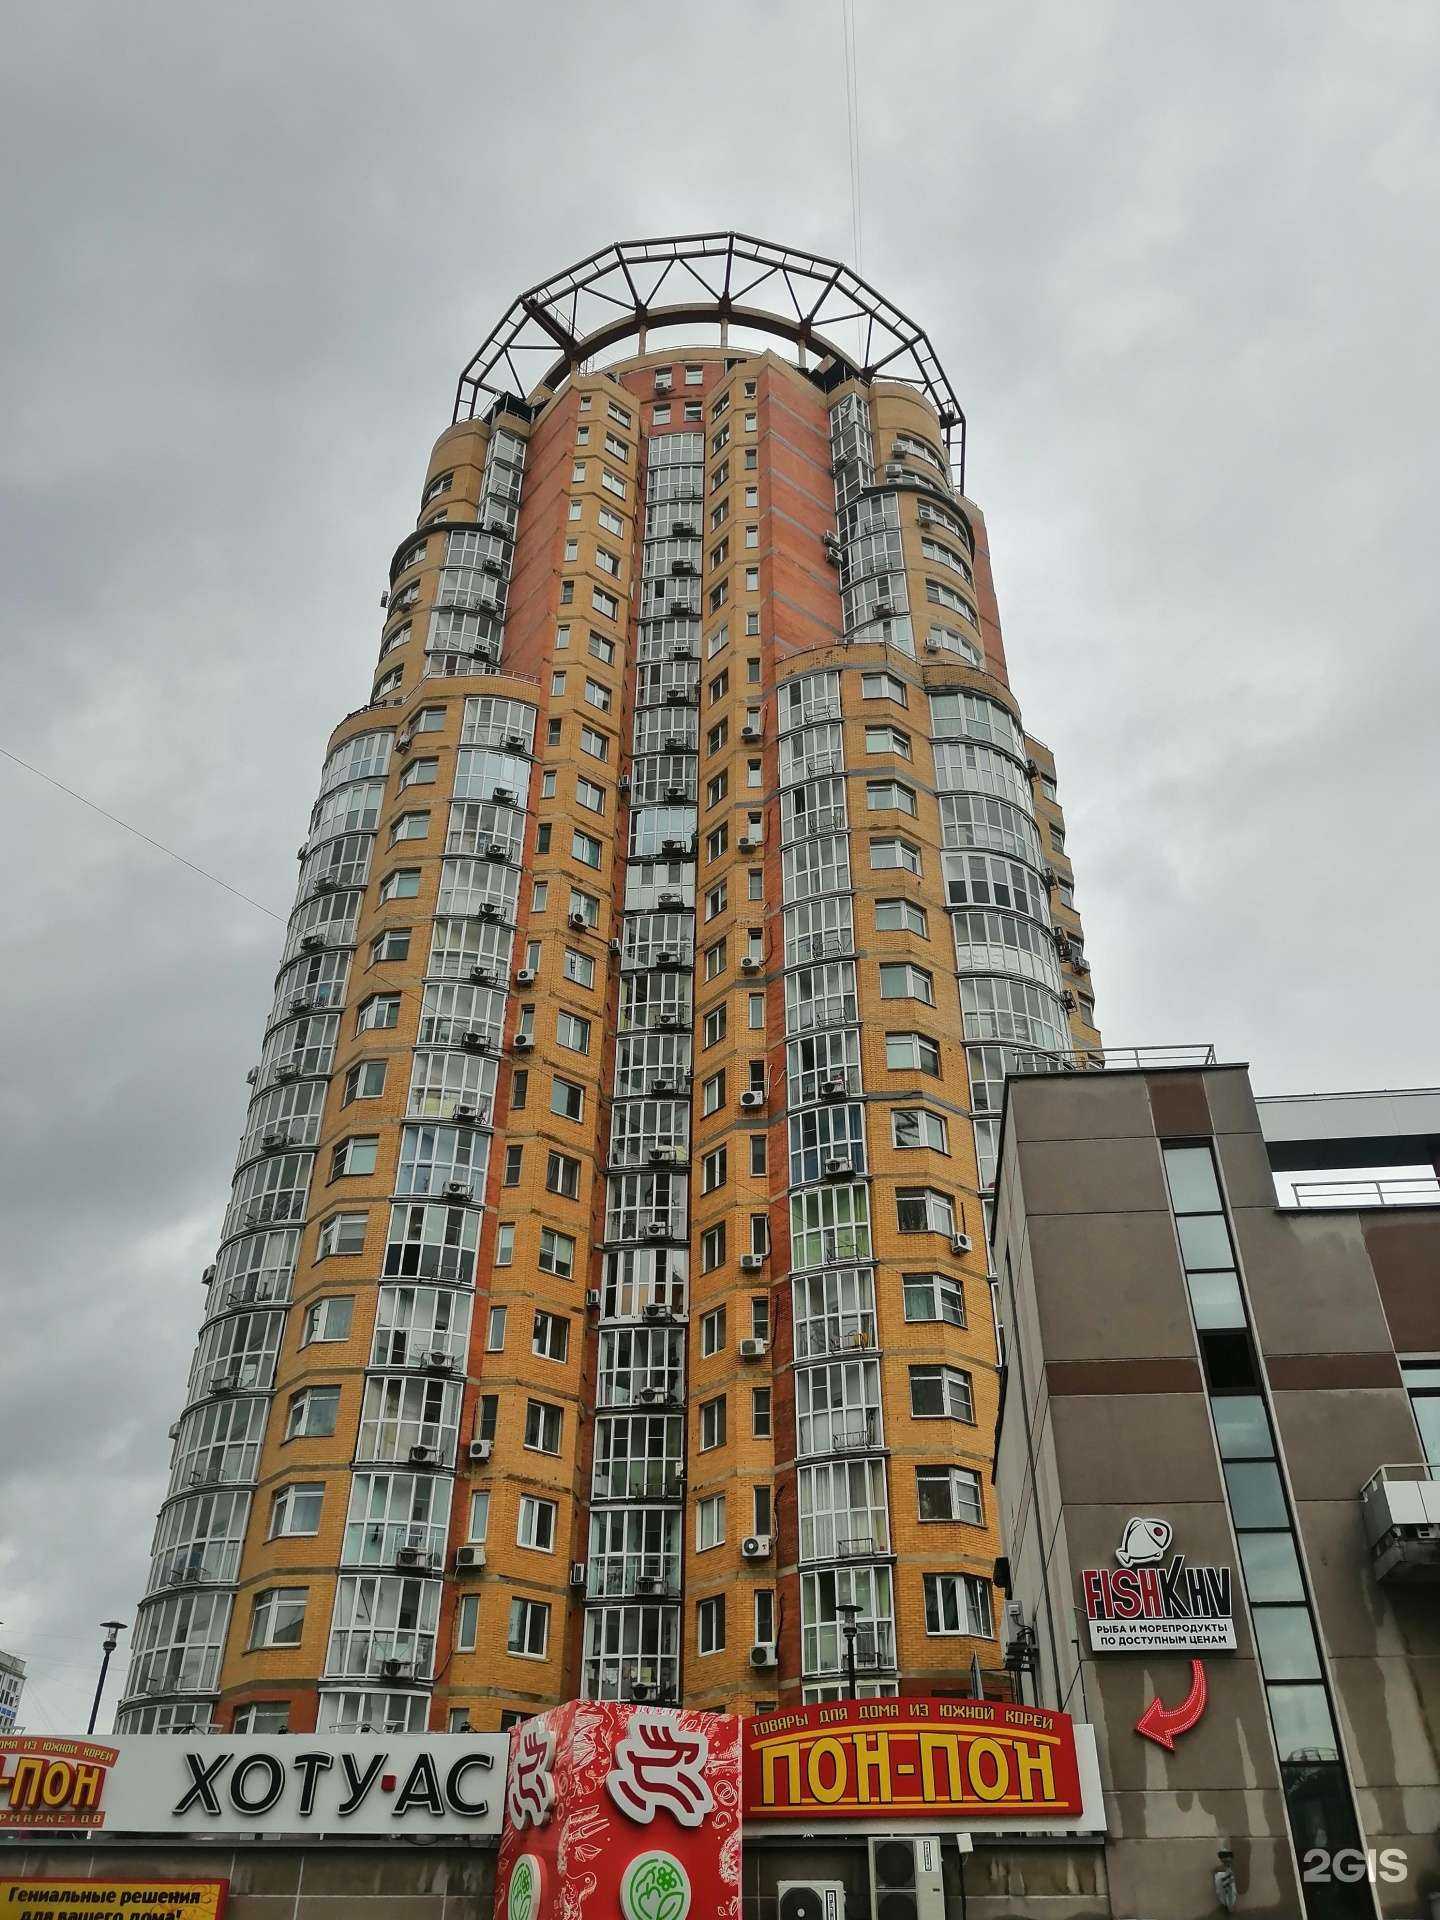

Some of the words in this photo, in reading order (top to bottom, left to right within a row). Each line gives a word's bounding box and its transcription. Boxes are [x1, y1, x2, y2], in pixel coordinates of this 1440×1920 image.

[1096, 1624, 1127, 1634] РЫБА
[1129, 1624, 1137, 1633] И
[1139, 1623, 1228, 1634] МОРЕПРОДУКТЫ
[1100, 1636, 1116, 1645] ПО
[1118, 1635, 1187, 1646] ДОСТУПНЫМ
[1189, 1635, 1227, 1645] ЦЕНАМ
[752, 1713, 809, 1737] ТОВАРЫ
[819, 1707, 849, 1724] ДЛЯ
[858, 1704, 899, 1720] ДОМА
[909, 1703, 929, 1717] ИЗ
[939, 1704, 995, 1721] ЮЖНОЙ
[1005, 1709, 1054, 1730] КОРЕИ
[23, 1740, 38, 1750] ИЗ
[42, 1741, 79, 1755] ЮЖНОЙ
[82, 1746, 114, 1761] КОРЕИ
[761, 1731, 1056, 1806] ПОН-ПОН
[8, 1886, 117, 1904] Гениальные
[119, 1890, 202, 1907] решения
